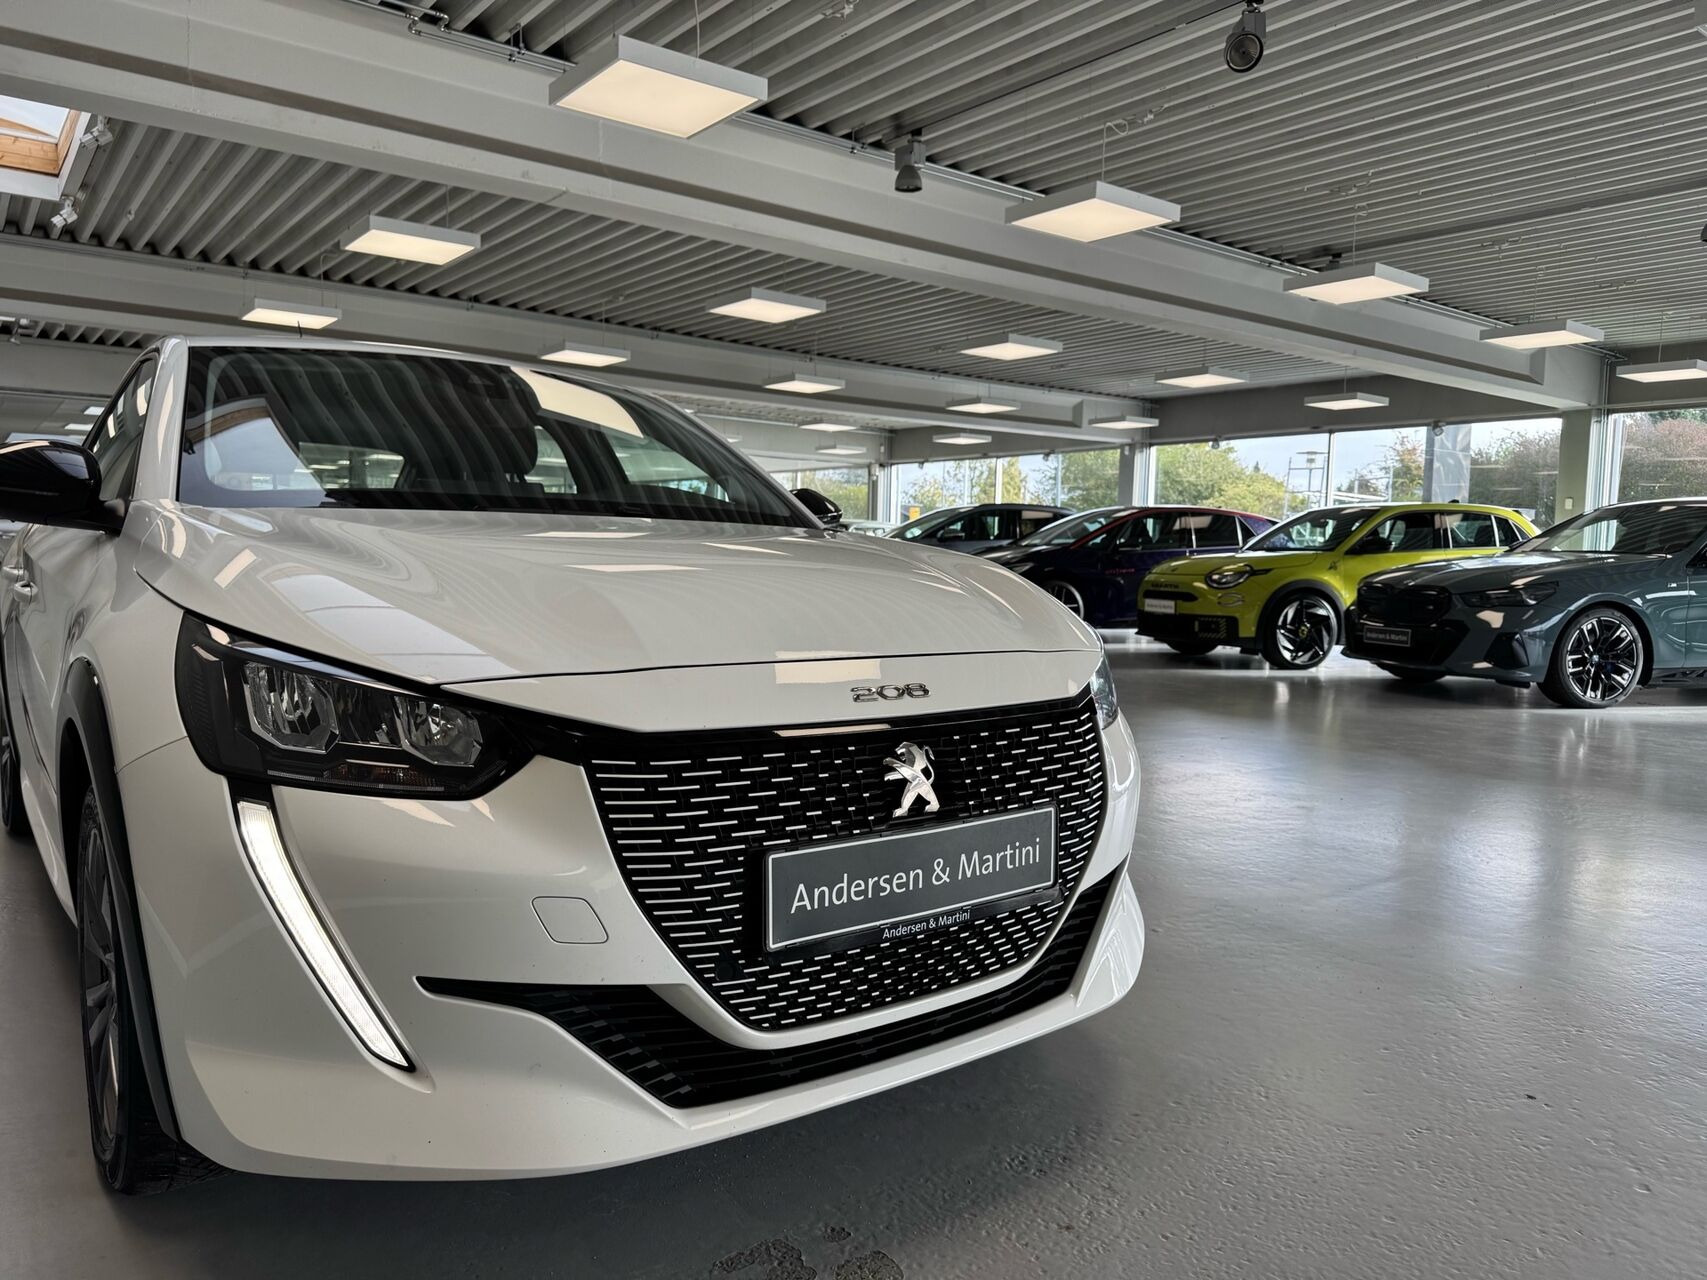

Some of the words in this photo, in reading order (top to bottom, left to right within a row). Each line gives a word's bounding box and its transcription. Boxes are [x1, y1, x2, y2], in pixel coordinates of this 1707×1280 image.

[850, 682, 931, 702] 208
[790, 868, 923, 914] Andersen
[931, 858, 950, 886] &
[958, 837, 1040, 880] Martini
[882, 922, 927, 939] Andersen
[928, 918, 936, 929] &
[938, 909, 970, 927] Martini
